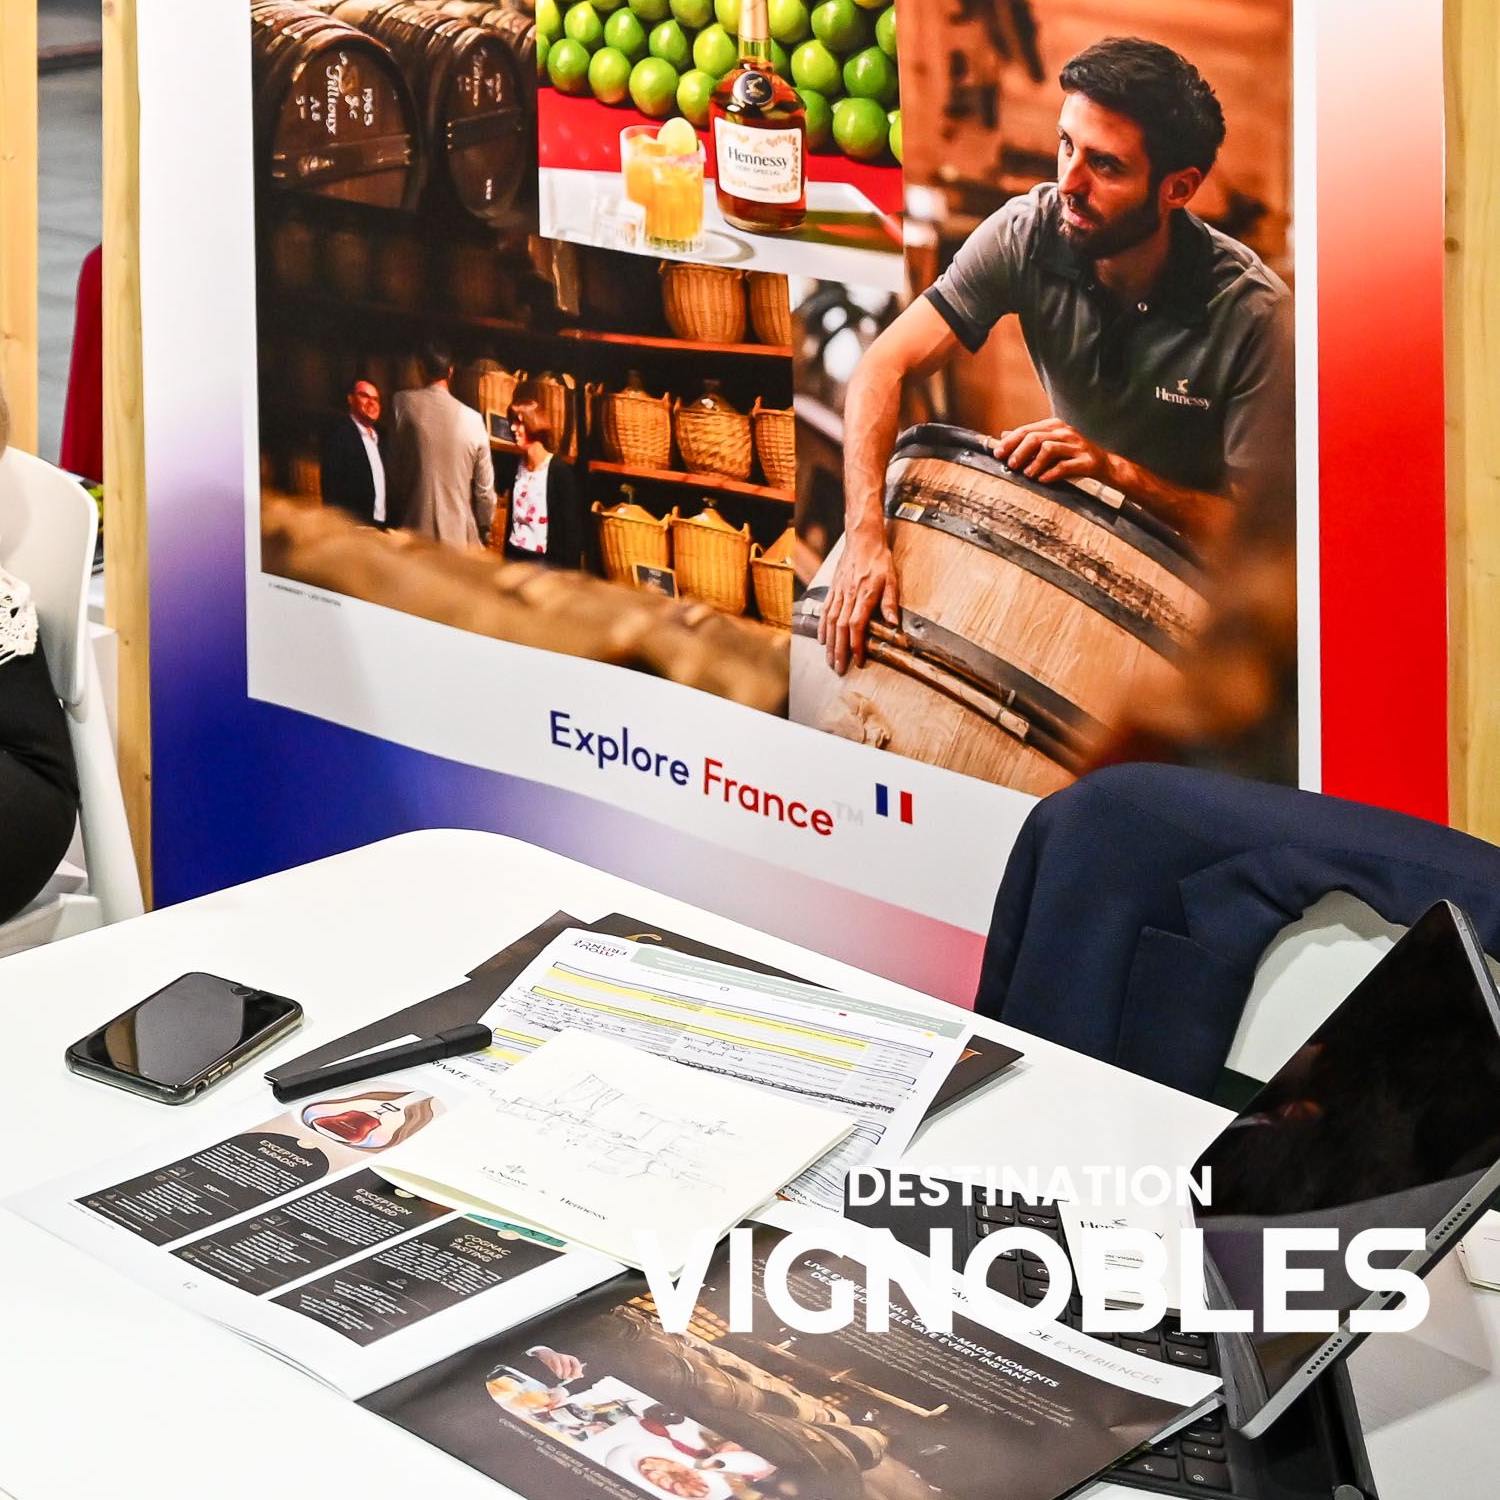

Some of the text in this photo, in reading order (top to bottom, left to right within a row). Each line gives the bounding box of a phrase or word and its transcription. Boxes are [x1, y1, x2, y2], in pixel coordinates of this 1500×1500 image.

[728, 145, 789, 170] Hennessy
[1155, 386, 1210, 410] Hennessy
[550, 710, 690, 786] Explore
[430, 1060, 471, 1080] RIVATE
[257, 1146, 298, 1169] PARADIS
[259, 1139, 313, 1168] EXCEPTION
[353, 1194, 398, 1218] RICHARD
[355, 1188, 413, 1216] EXCEPTION
[560, 1197, 608, 1221] Hennessy
[449, 1242, 494, 1264] TASTING
[464, 1233, 512, 1257] COGNAC
[465, 1241, 503, 1261] CAVIAR
[804, 1260, 830, 1276] LIVE
[994, 1354, 1060, 1388] MOMENTS
[938, 1334, 979, 1360] EVERY
[977, 1355, 1033, 1385] INSTANT.
[1052, 1339, 1164, 1386] EXPERIENCES
